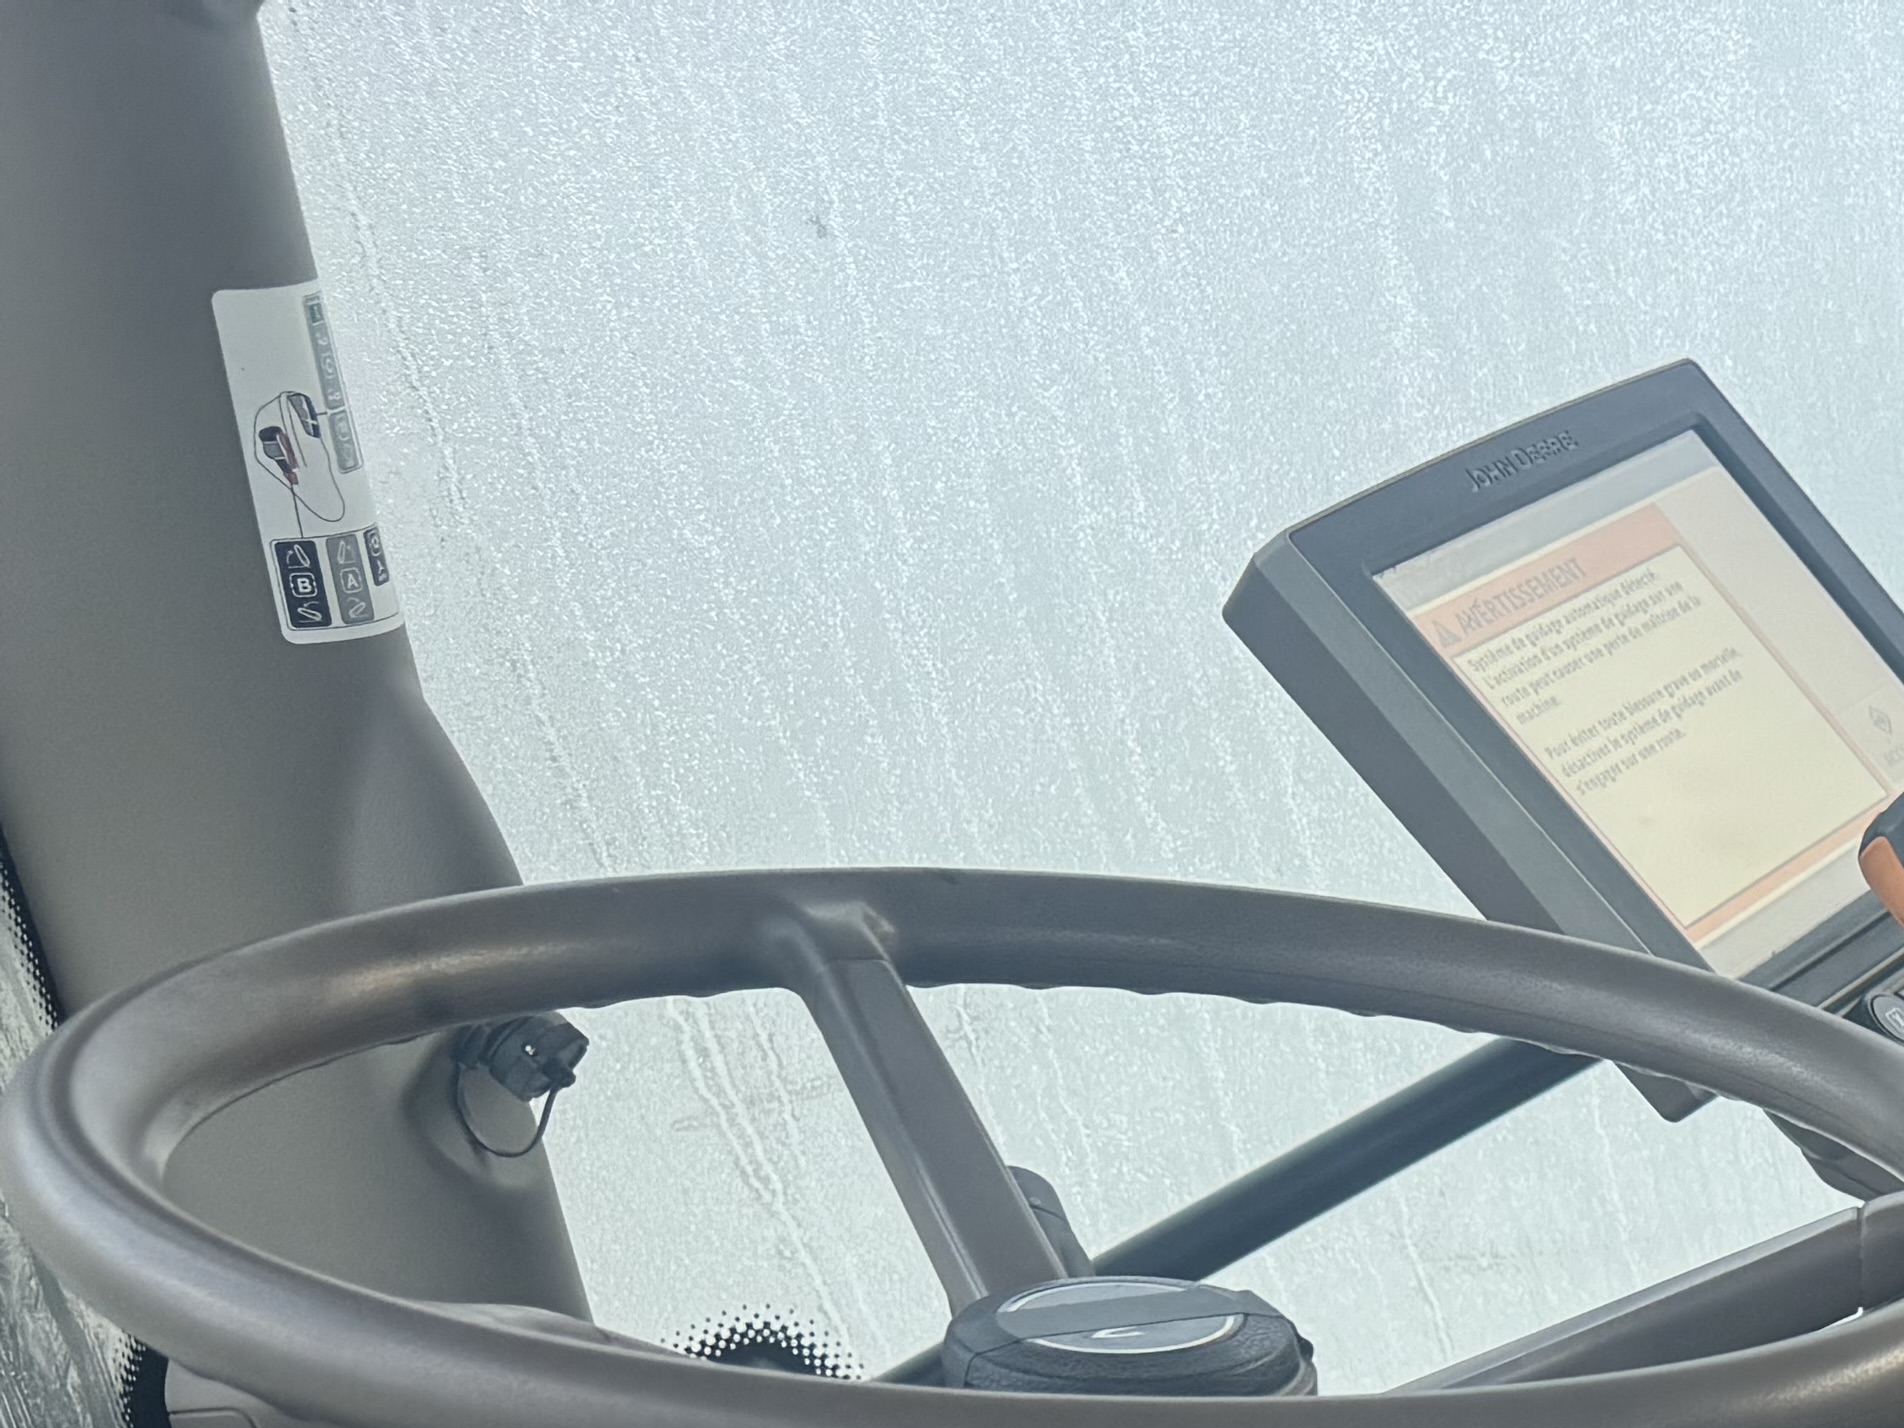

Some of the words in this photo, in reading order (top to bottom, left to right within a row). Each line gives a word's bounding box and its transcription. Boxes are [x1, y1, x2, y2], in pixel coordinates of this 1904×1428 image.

[1464, 456, 1519, 492] JOHN
[1510, 430, 1578, 465] DEERE
[297, 578, 312, 593] B
[347, 573, 359, 589] A
[1597, 613, 1616, 629] de
[1624, 623, 1644, 640] de
[1674, 597, 1693, 613] de
[1508, 635, 1528, 651] de
[1652, 705, 1674, 723] de
[1725, 665, 1744, 682] de
